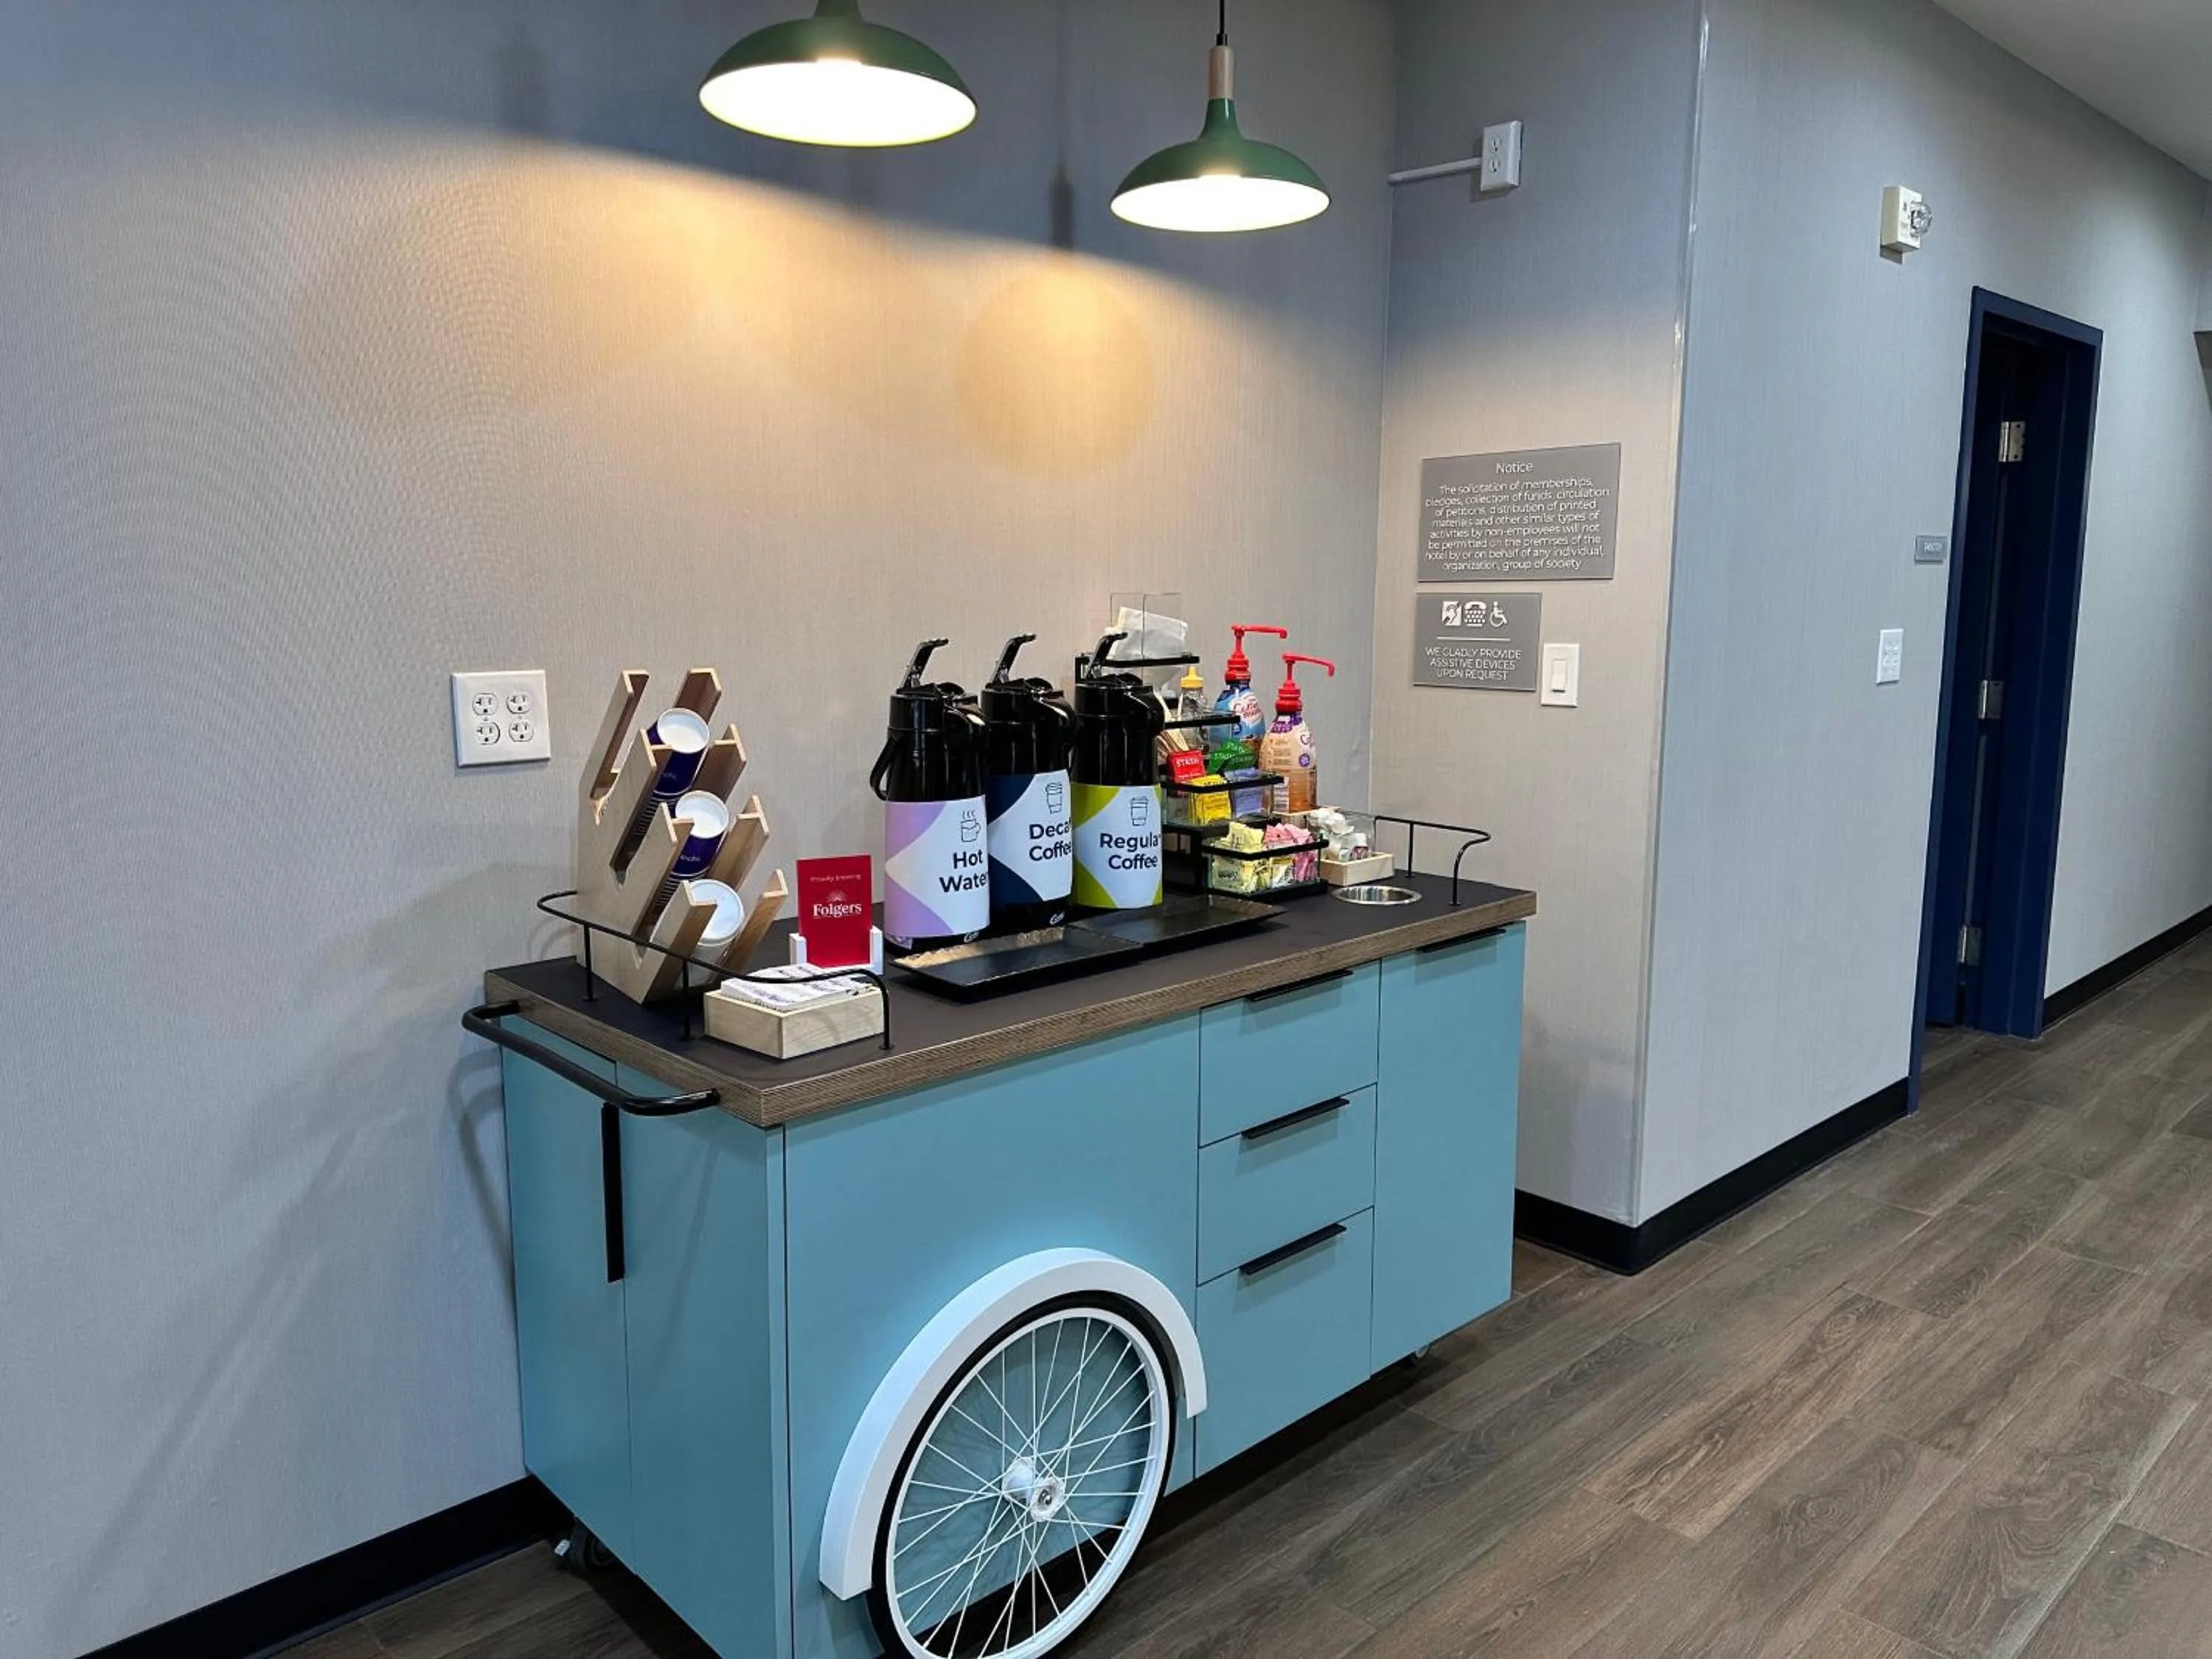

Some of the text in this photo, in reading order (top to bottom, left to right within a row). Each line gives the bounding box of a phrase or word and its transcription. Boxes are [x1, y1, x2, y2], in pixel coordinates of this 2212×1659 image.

[1496, 460, 1534, 474] Notice
[1439, 484, 1456, 495] The
[1509, 480, 1520, 490] of
[1465, 493, 1510, 505] collection
[1512, 492, 1523, 502] of
[1557, 486, 1610, 499] circulation
[1435, 507, 1445, 517] of
[1489, 501, 1545, 515] distribution
[1547, 501, 1557, 511] of
[1559, 498, 1597, 511] printed
[1433, 518, 1474, 529] materials
[1475, 515, 1494, 526] and
[1495, 515, 1521, 526] other
[1558, 512, 1586, 524] types
[1589, 509, 1601, 521] of
[1471, 527, 1482, 539] by
[1484, 525, 1561, 538] non-employees
[1582, 523, 1601, 532] not
[1428, 540, 1440, 550] be
[1489, 539, 1502, 548] on
[1505, 537, 1522, 547] the
[1571, 535, 1582, 545] of
[1583, 533, 1603, 544] the
[1449, 549, 1460, 562] by
[1462, 550, 1472, 560] or
[1474, 550, 1487, 559] on
[1489, 548, 1519, 559] behalf
[1521, 547, 1531, 557] of
[1533, 548, 1551, 560] any
[1503, 560, 1531, 571] group
[1425, 647, 1523, 660] WE GLADLY PROVIDE
[1430, 657, 1516, 670] ASSISTIVE DEVICES
[1436, 668, 1509, 681] UPON REQUEST
[1175, 758, 1200, 767] STASH
[953, 849, 983, 869] Hot
[1108, 853, 1158, 870] Coffee
[813, 903, 862, 918] Folgers
